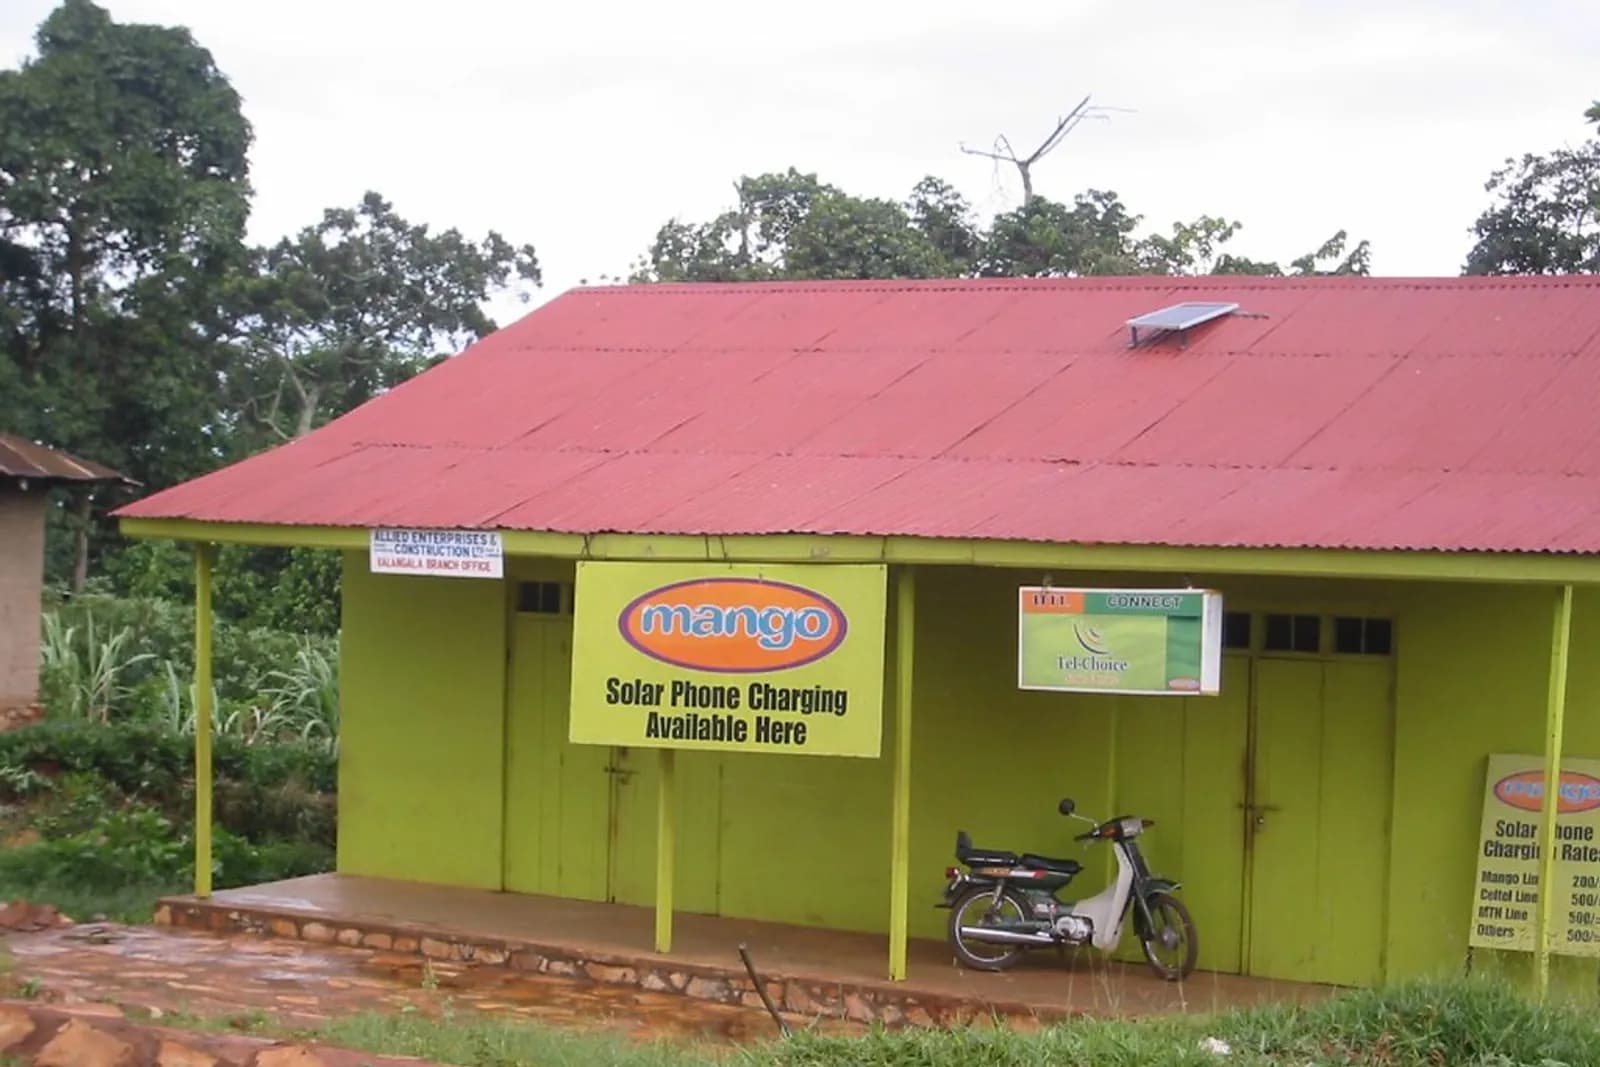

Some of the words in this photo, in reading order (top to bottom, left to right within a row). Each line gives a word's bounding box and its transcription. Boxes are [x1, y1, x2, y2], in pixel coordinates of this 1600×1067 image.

[375, 530, 409, 543] ALLIED
[411, 532, 487, 545] ENTERPRISES
[393, 543, 470, 558] CONSTRUCTION
[426, 559, 459, 570] BRANCH
[461, 560, 491, 572] OFFICE
[1106, 594, 1183, 609] CONNECT
[640, 604, 832, 651] mango
[605, 677, 665, 706] Solar
[670, 681, 741, 710] Phone
[747, 683, 848, 716] Charging
[645, 712, 748, 742] Available
[755, 716, 807, 745] Here
[1504, 781, 1600, 805] mago
[1495, 819, 1538, 839] Solar
[1554, 822, 1594, 841] hone
[1481, 871, 1520, 886] Mango
[1522, 873, 1540, 886] Lin
[1504, 907, 1529, 921] Line
[1476, 923, 1515, 938] Others
